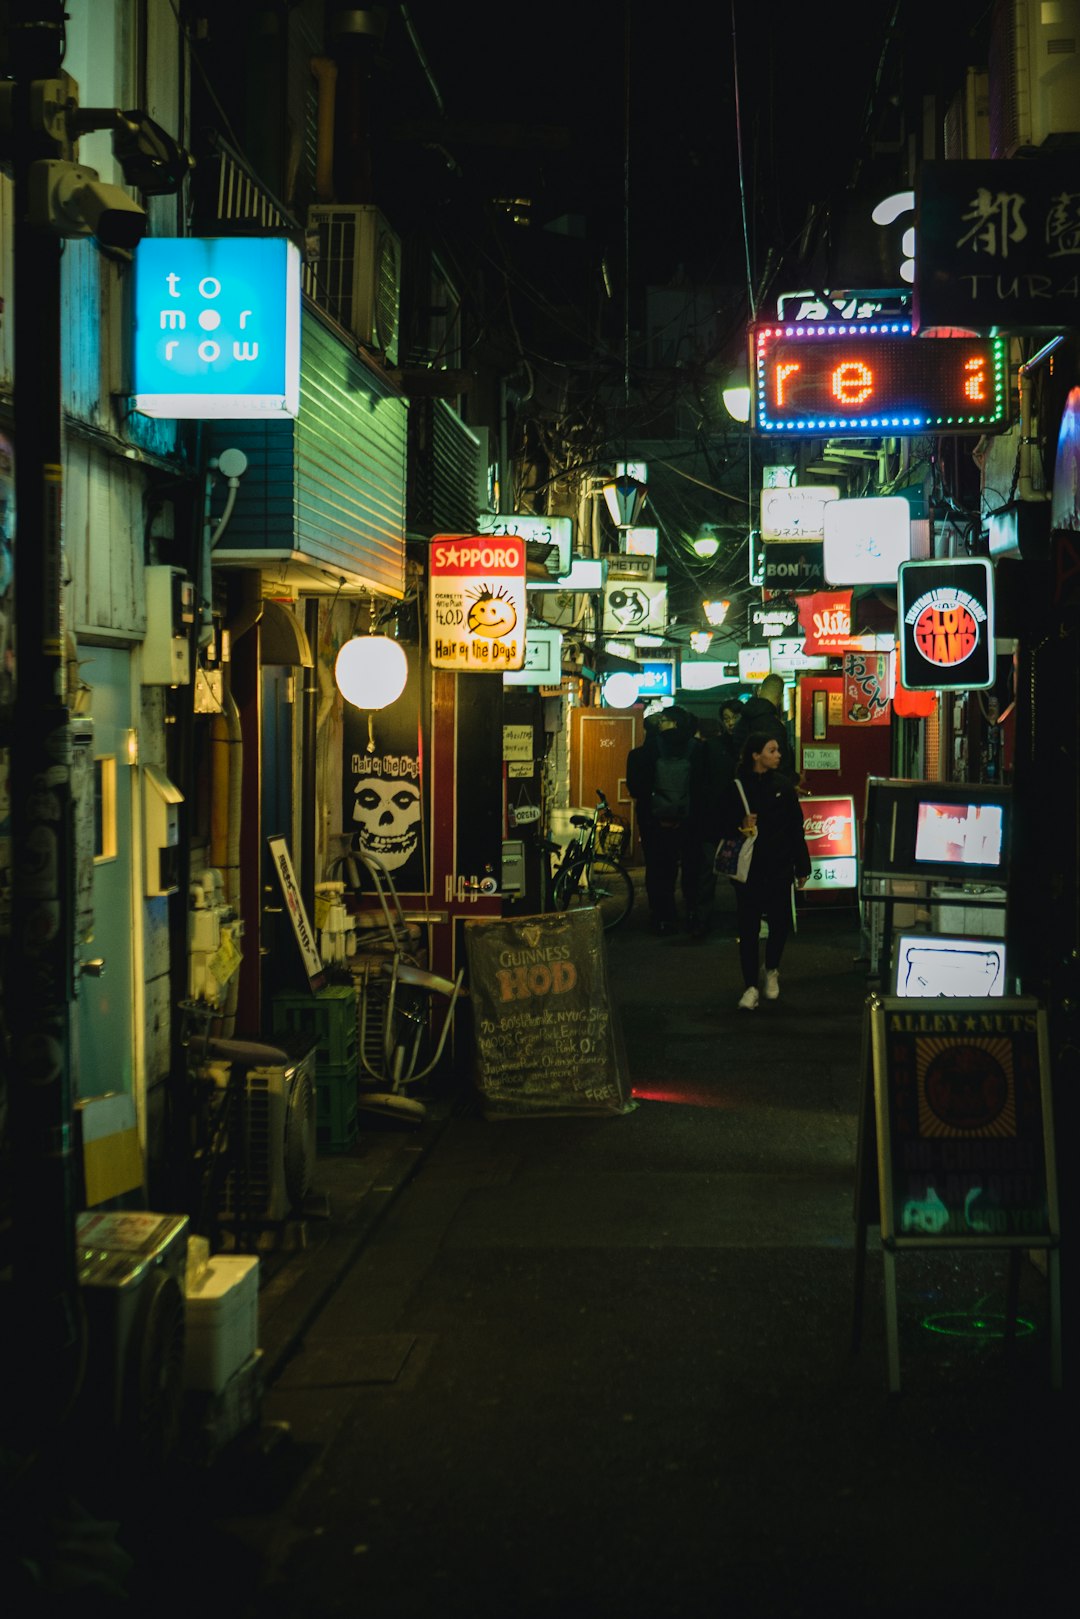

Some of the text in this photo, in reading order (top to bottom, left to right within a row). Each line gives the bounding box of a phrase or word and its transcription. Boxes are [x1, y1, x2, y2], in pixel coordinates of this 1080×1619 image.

[916, 604, 976, 635] SLOW
[435, 640, 457, 659] Hair
[472, 640, 489, 659] the
[492, 642, 517, 662] Dogs
[916, 633, 975, 664] HAND
[845, 654, 889, 708] おでん
[352, 755, 372, 773] Hair
[384, 756, 399, 774] the
[499, 945, 571, 967] GUINNESS
[495, 961, 577, 1002] HOD
[889, 1014, 1038, 1033] ALLEY NUTS
